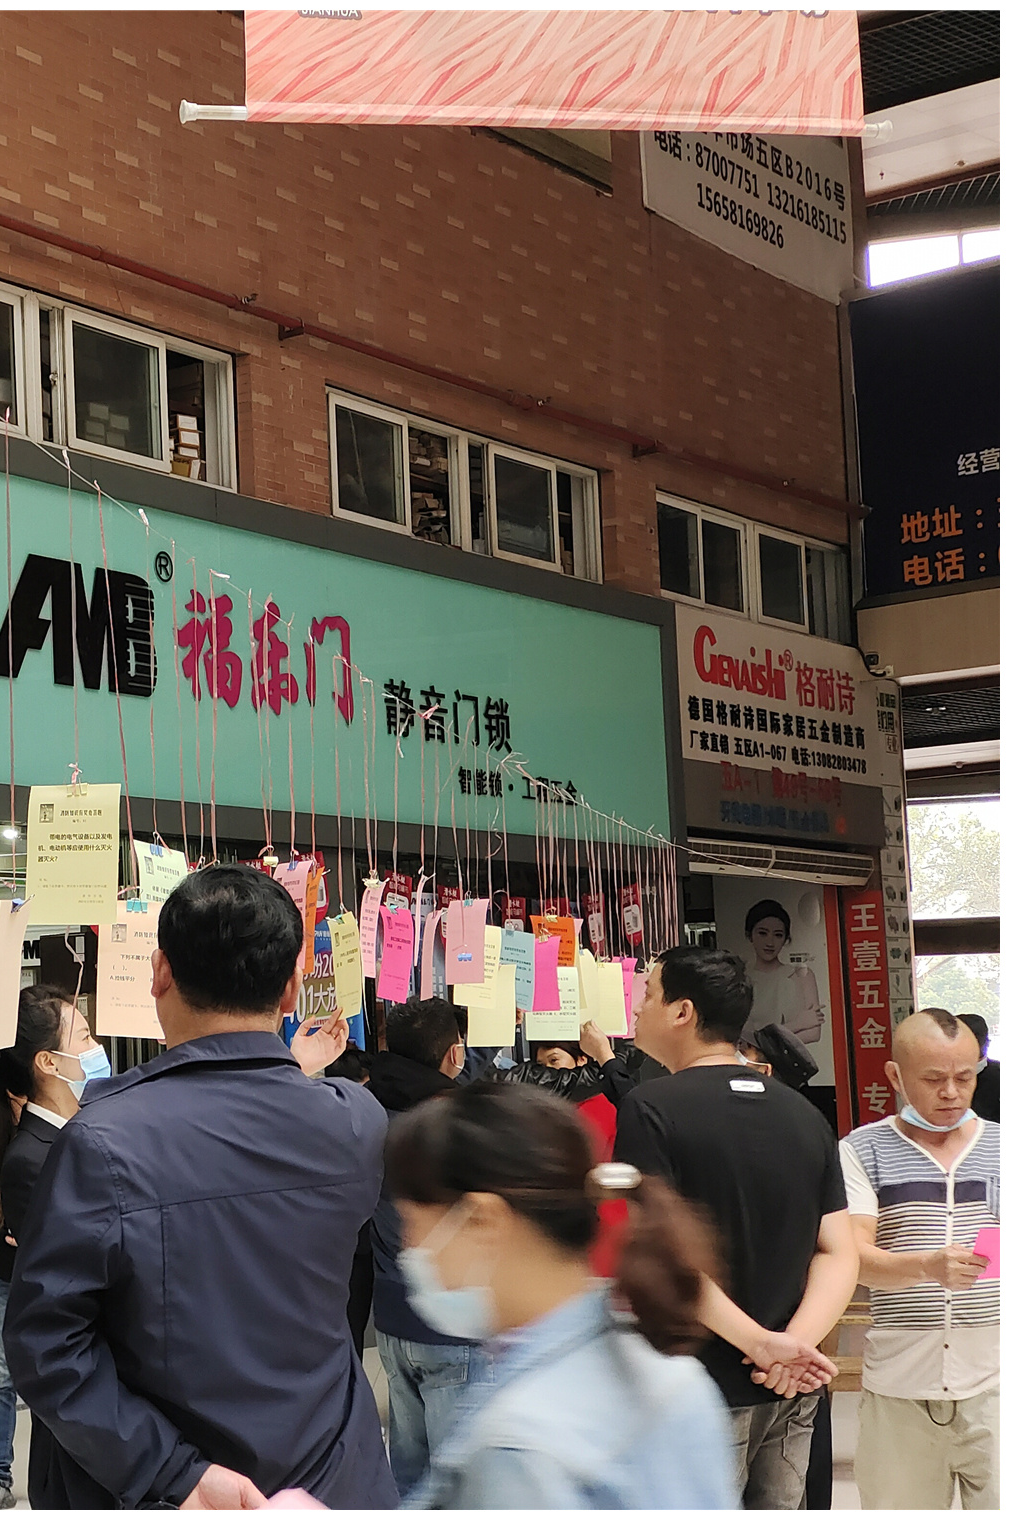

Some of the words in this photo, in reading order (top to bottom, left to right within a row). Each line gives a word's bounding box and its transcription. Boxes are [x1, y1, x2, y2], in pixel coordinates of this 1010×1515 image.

[696, 182, 784, 249] 15658169826
[767, 182, 847, 244] 13216185115
[900, 503, 1000, 545] 地址：
[902, 547, 1000, 586] 电话：
[383, 678, 513, 754] 静音门锁
[795, 660, 856, 716] 格耐诗
[689, 730, 730, 755] 厂家直销
[849, 902, 887, 1050] 王壹五金
